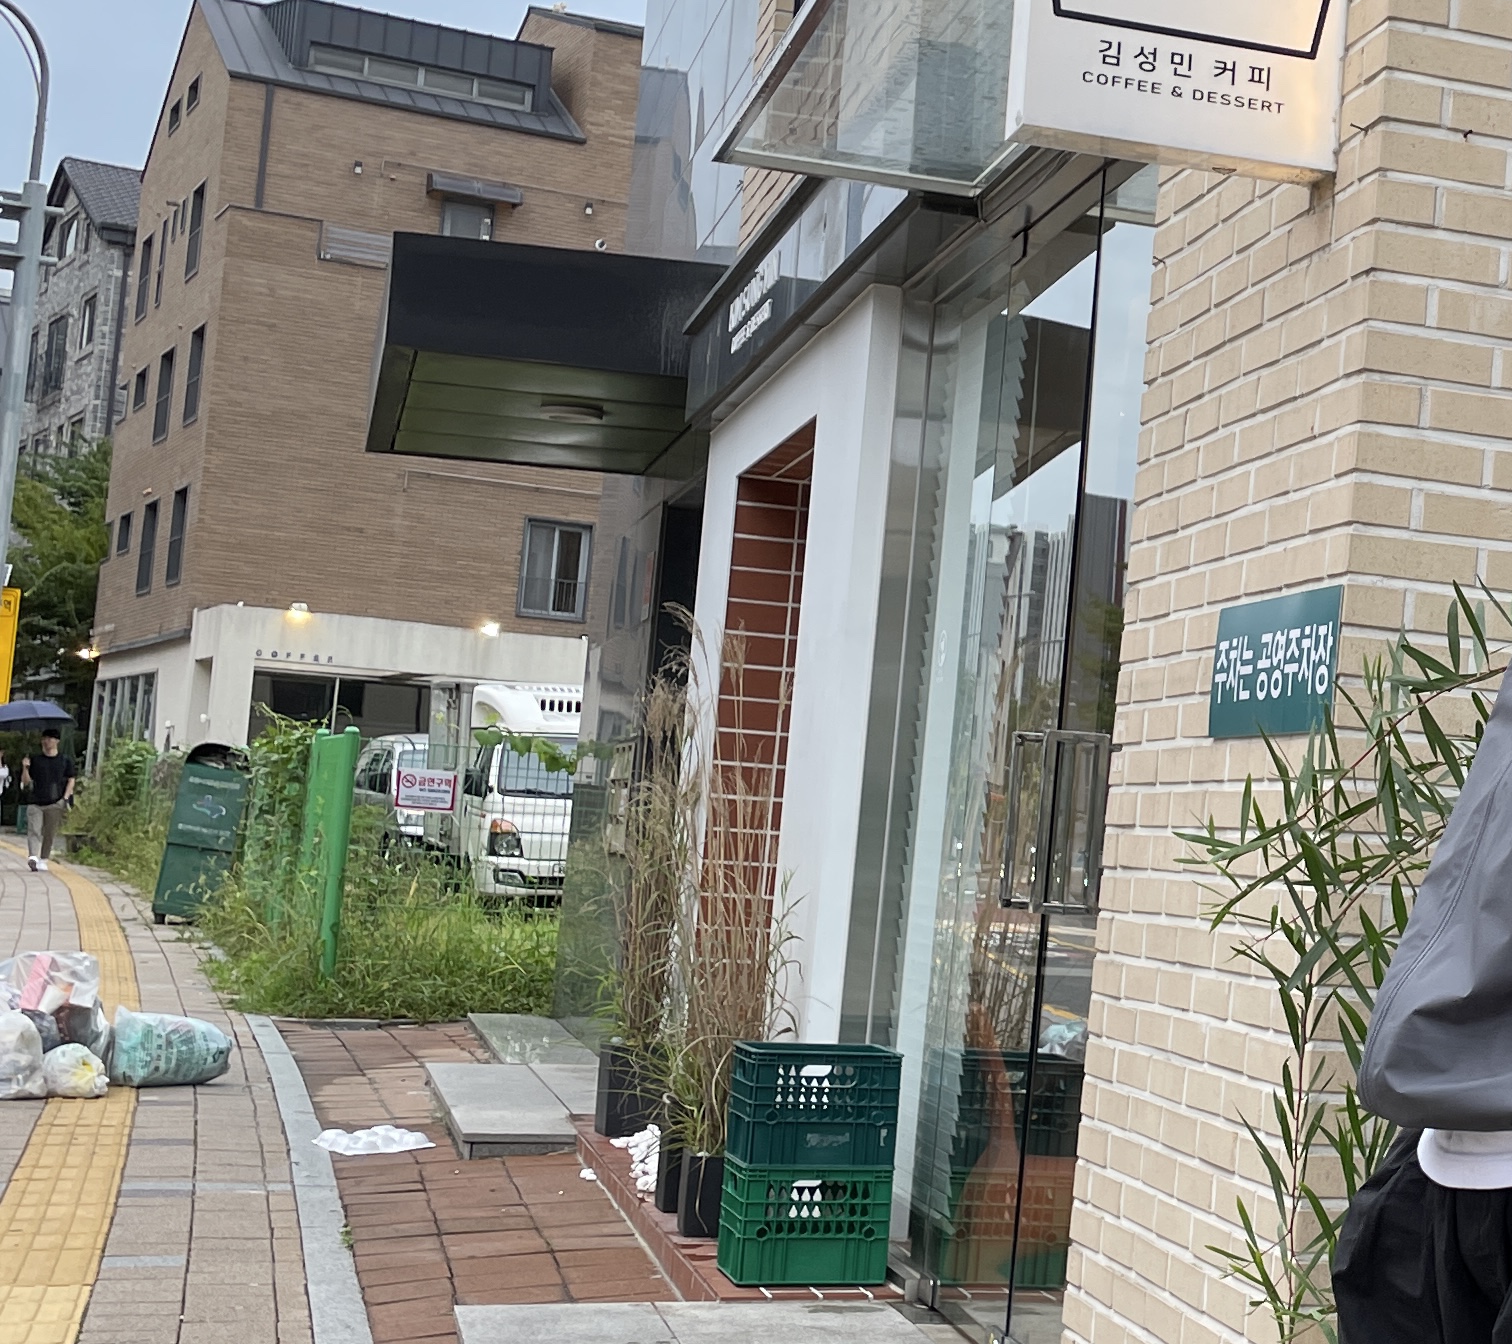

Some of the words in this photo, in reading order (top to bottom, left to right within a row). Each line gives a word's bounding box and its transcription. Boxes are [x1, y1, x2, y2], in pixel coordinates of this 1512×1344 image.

[1098, 40, 1193, 79] 김성민
[1213, 60, 1271, 91] 커피
[1082, 71, 1161, 94] COFFEE
[1171, 85, 1183, 98] &
[1193, 89, 1285, 114] DESSERT
[1214, 636, 1253, 704] 주차는
[1256, 621, 1334, 701] 공영주차장
